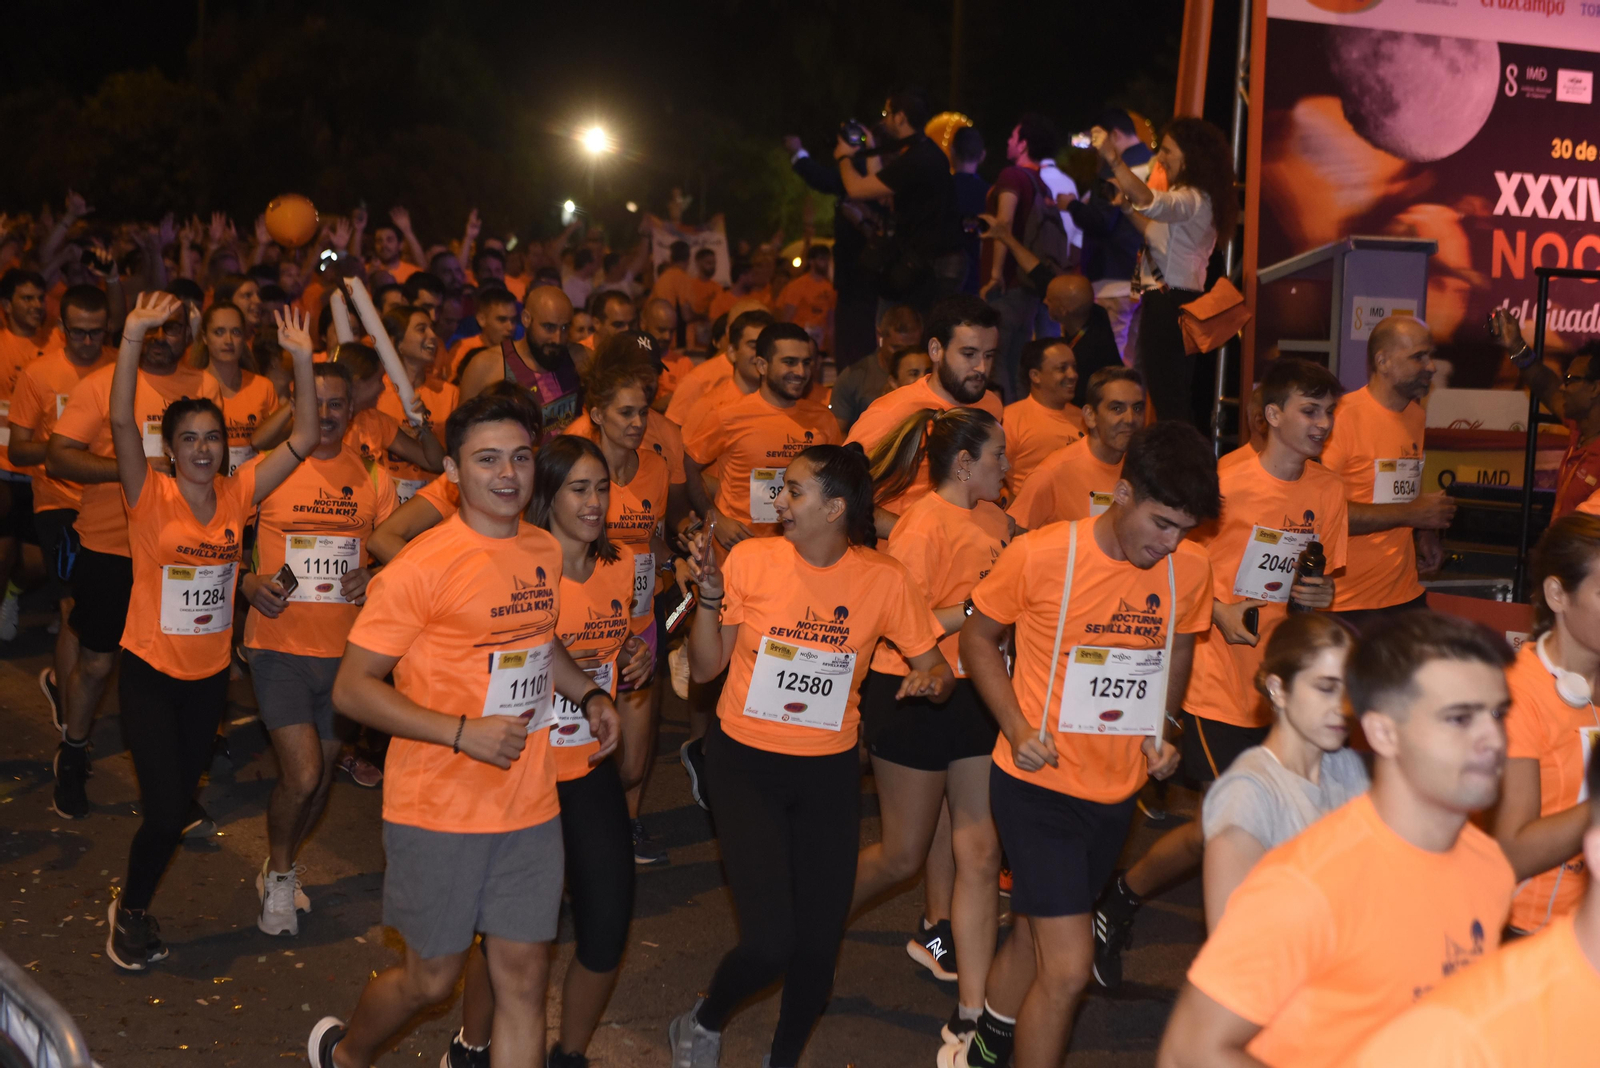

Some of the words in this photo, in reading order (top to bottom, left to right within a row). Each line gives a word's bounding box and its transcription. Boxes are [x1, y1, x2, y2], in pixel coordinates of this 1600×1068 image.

[1526, 66, 1548, 82] IMD
[1551, 137, 1573, 159] 30
[1575, 139, 1598, 162] de
[1369, 307, 1385, 318] IMD
[1393, 480, 1416, 496] 6634
[292, 505, 334, 515] SEVILLA
[313, 499, 358, 508] NOCTURNA
[176, 545, 217, 559] SEVILLA
[303, 557, 349, 575] 11110
[182, 586, 226, 606] 11284
[511, 588, 554, 602] NOCTURNA
[490, 602, 533, 618] SEVILLA
[584, 618, 628, 630] NOCTURNA
[1110, 613, 1163, 625] NOCTURNA
[769, 626, 818, 642] SEVILLA
[796, 620, 850, 635] NOCTURNA
[510, 671, 549, 700] 11101
[776, 669, 833, 697] 12580
[1089, 676, 1148, 700] 12578
